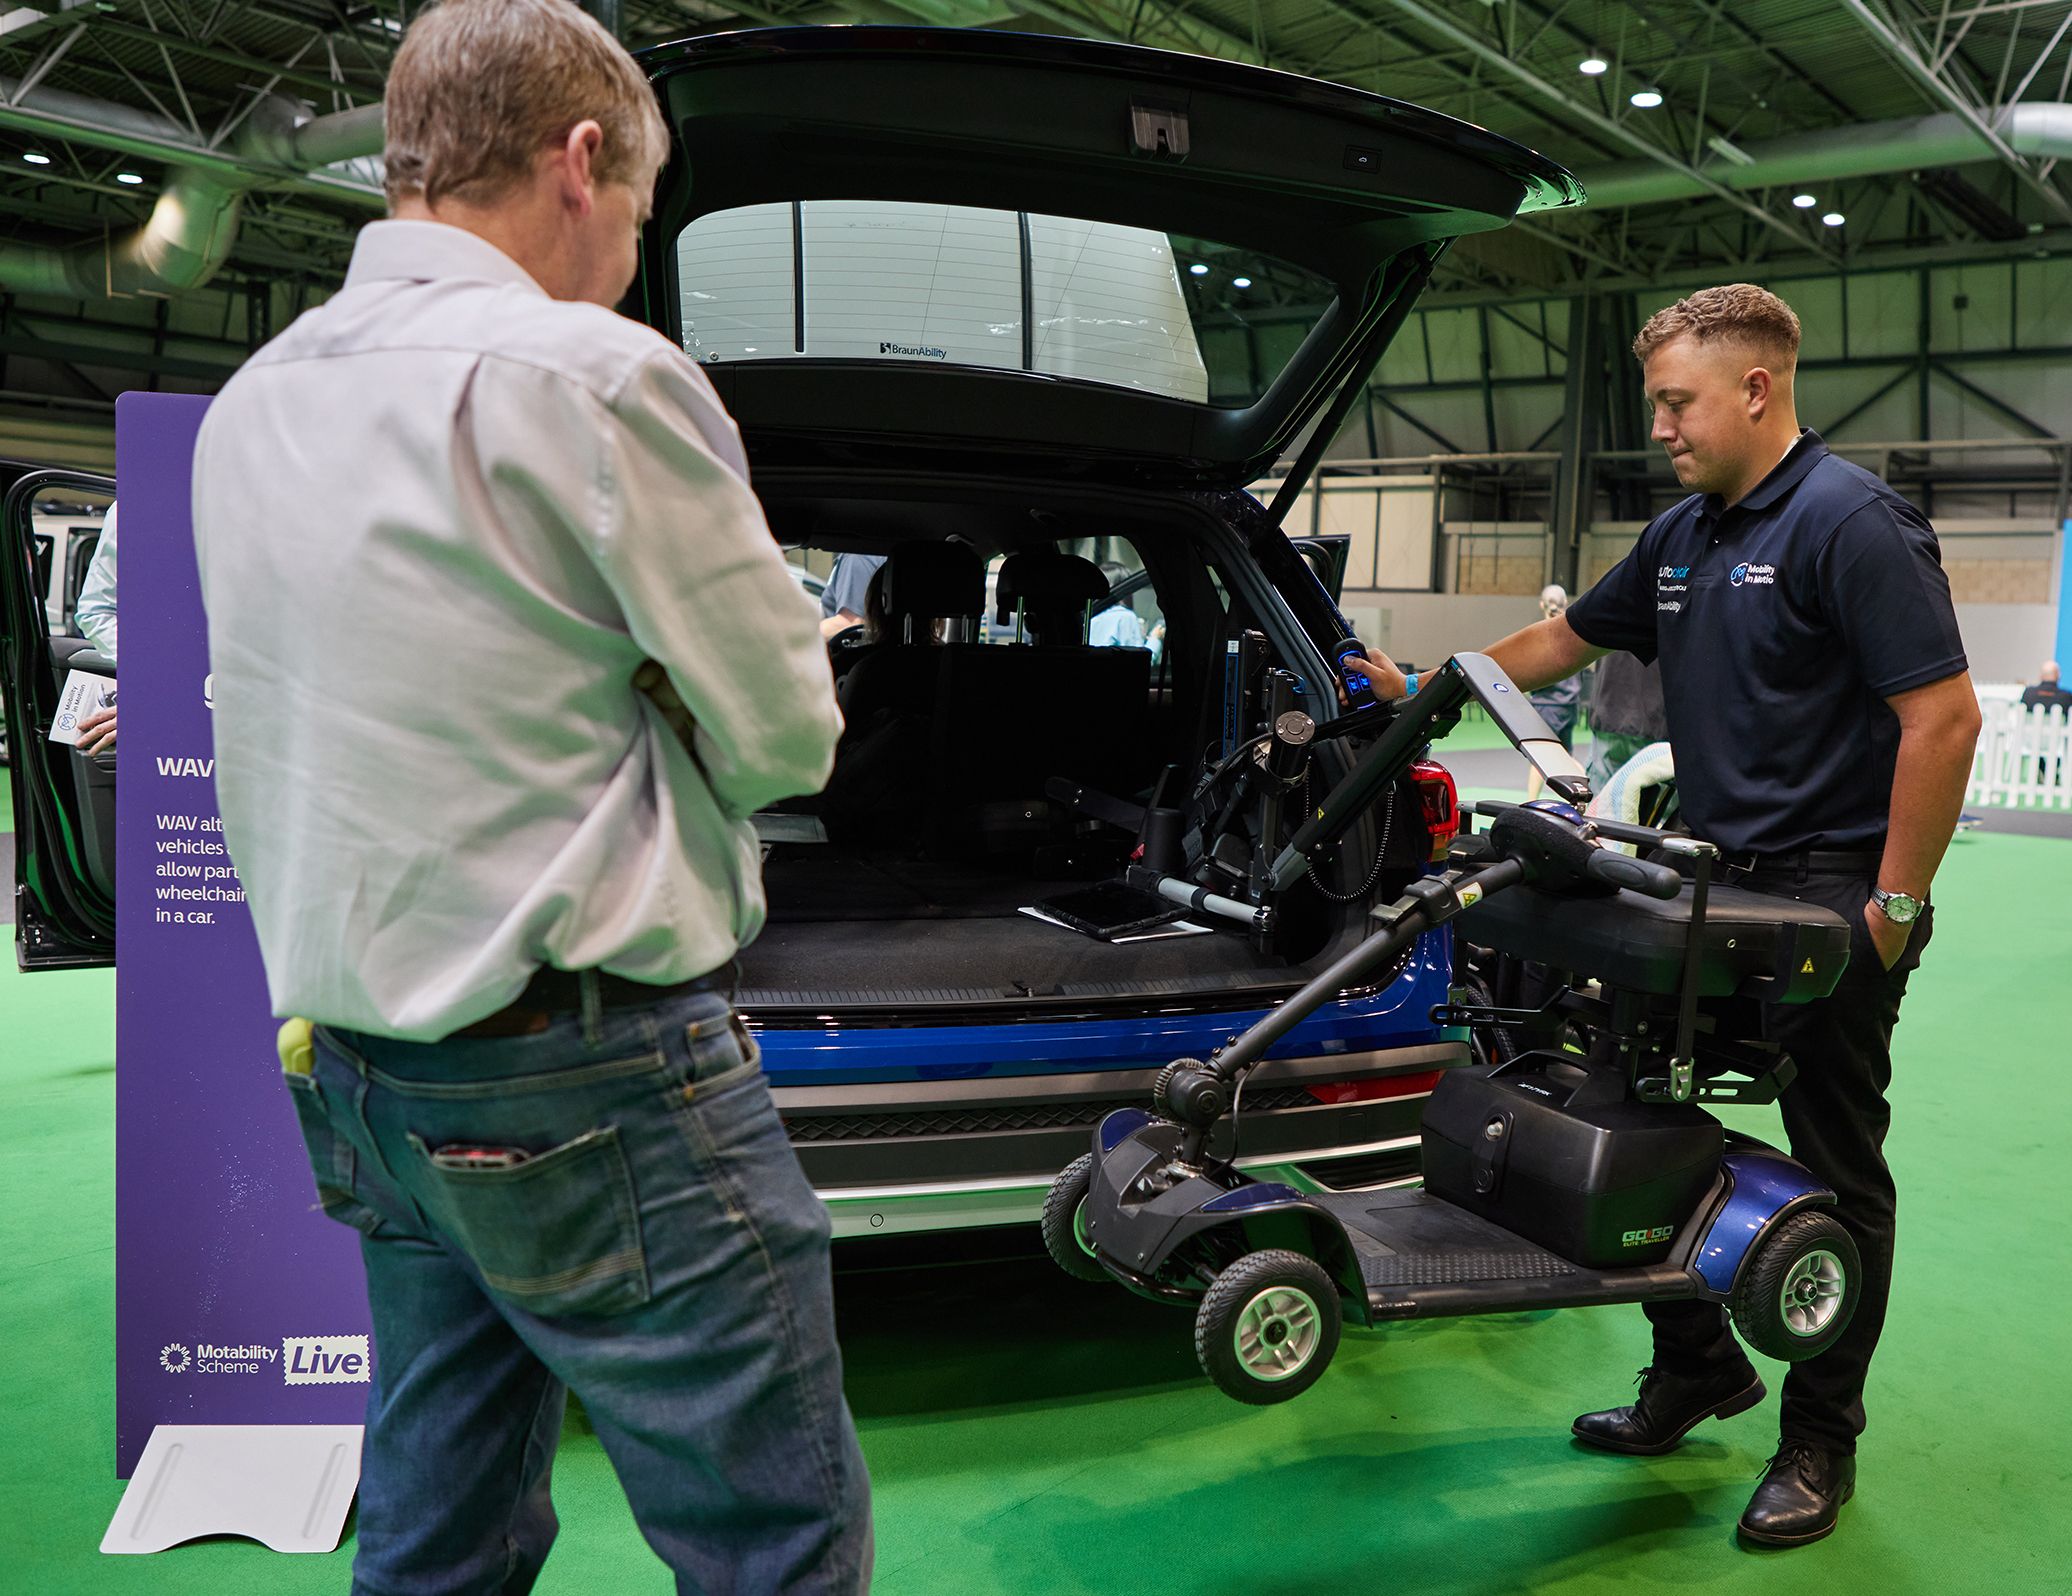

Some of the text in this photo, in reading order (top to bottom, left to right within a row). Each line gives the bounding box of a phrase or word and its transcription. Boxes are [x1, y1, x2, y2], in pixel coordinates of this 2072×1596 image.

[892, 344, 947, 360] BraunAbility
[1747, 564, 1775, 577] Mobility
[1745, 574, 1774, 585] in Motio
[65, 685, 78, 711] Mobility
[75, 684, 86, 705] Motion
[156, 757, 214, 778] WAV
[156, 814, 226, 832] WAV alt
[156, 838, 224, 855] vehicles
[156, 861, 201, 877] allow
[156, 907, 216, 924] in a car.
[1641, 1236, 1670, 1245] TRAVELLER
[197, 1344, 279, 1363] Motability
[290, 1344, 363, 1375] Live
[197, 1359, 259, 1373] Scheme
